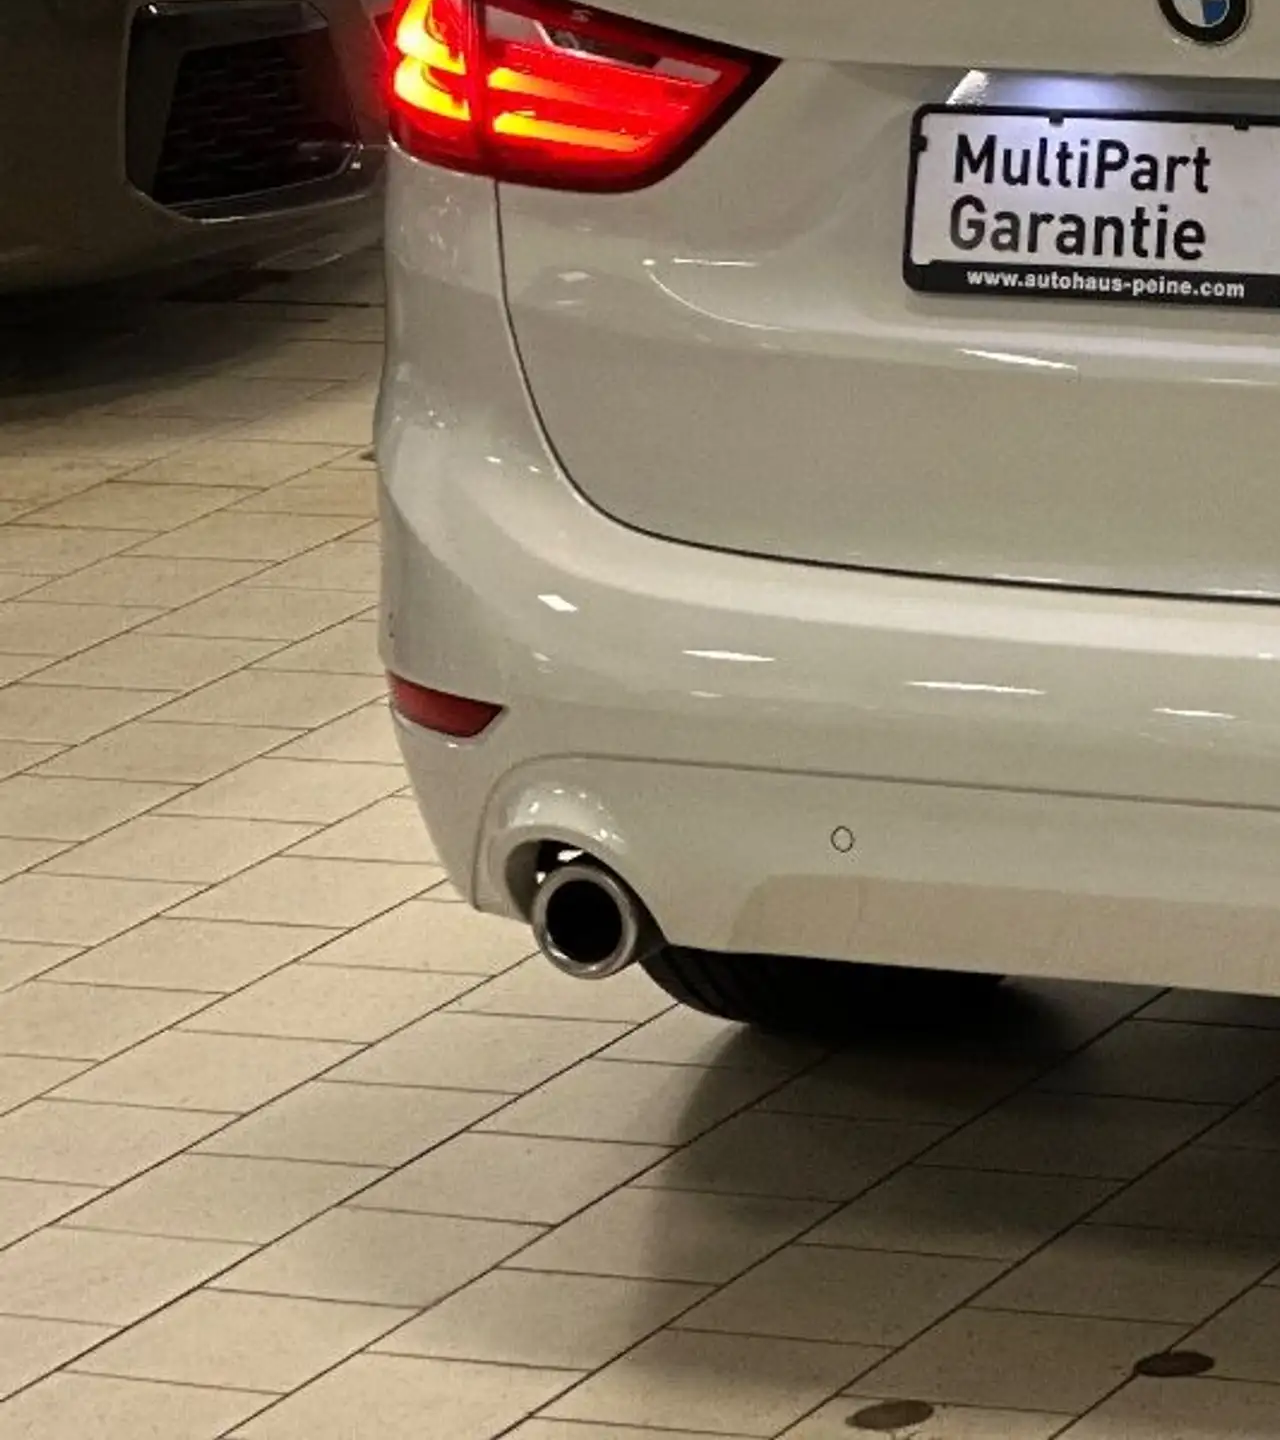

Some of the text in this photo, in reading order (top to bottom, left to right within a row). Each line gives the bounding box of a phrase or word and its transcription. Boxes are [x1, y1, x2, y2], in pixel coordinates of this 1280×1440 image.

[953, 134, 1211, 194] MultiPart
[948, 194, 1206, 261] Garantie
[967, 270, 1244, 298] www.autohaus-peine.com
